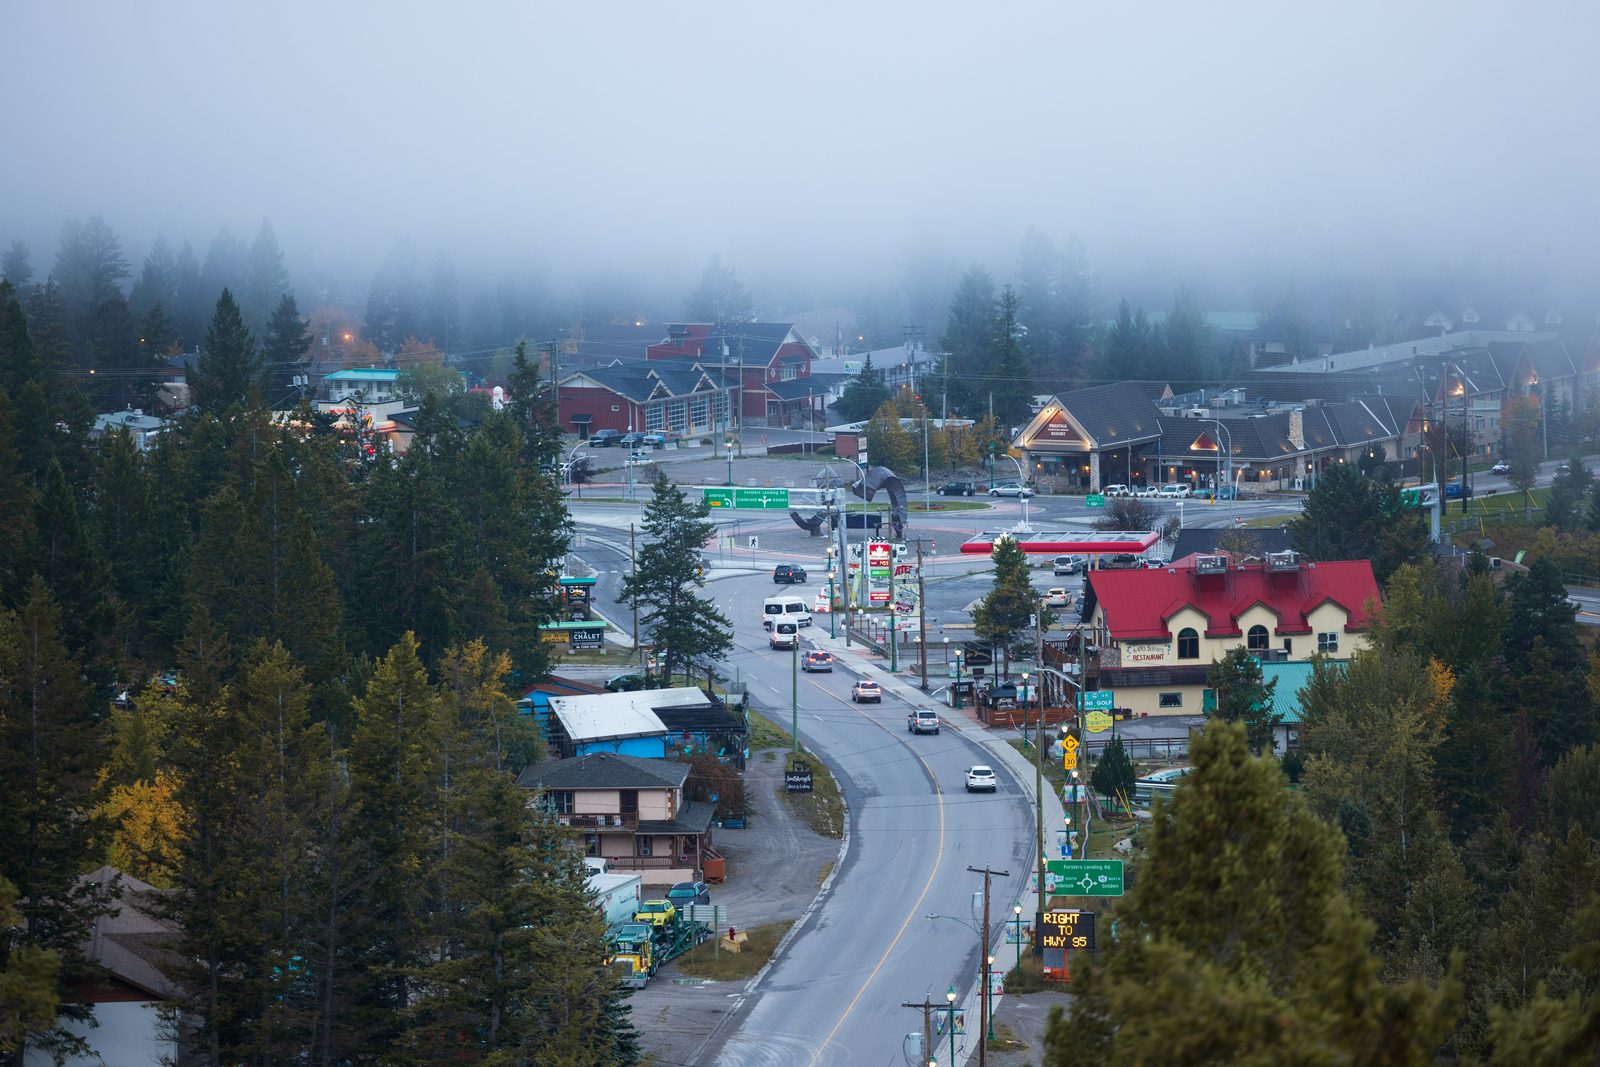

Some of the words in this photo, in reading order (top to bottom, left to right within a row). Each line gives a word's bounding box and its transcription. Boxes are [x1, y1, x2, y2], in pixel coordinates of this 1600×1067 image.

[1044, 914, 1080, 924] RIGHT
[1058, 926, 1072, 936] TO
[1044, 936, 1066, 946] HWY
[1072, 936, 1086, 947] 95
